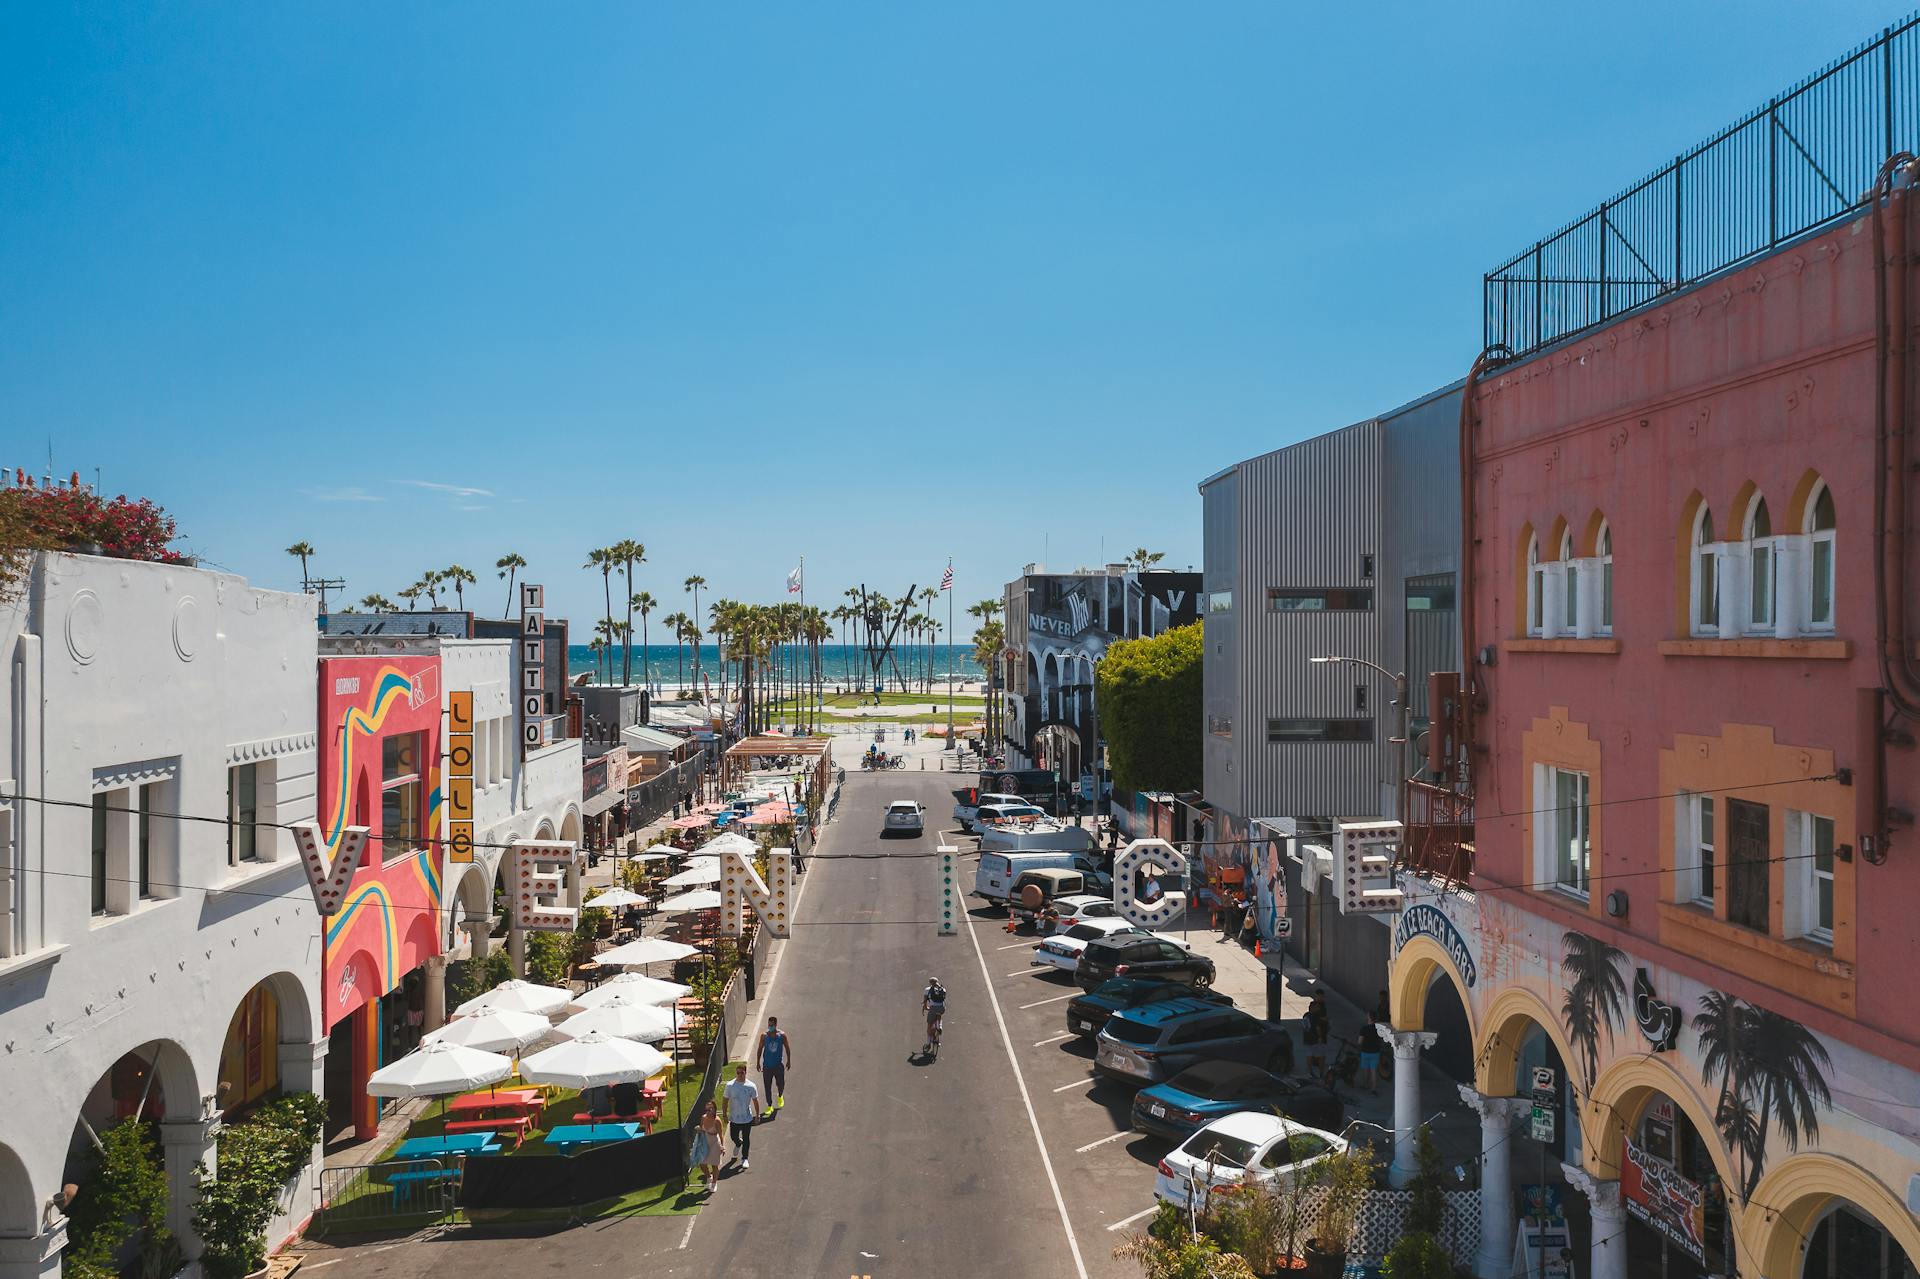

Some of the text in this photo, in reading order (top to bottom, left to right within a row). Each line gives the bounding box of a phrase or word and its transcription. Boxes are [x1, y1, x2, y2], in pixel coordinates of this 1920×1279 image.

[1029, 612, 1071, 636] NEVER
[526, 587, 539, 742] TATTOO
[1416, 907, 1445, 944] BEACH
[1447, 928, 1473, 985] MART
[1627, 1145, 1660, 1179] GRAND
[1660, 1166, 1701, 1207] OPENING
